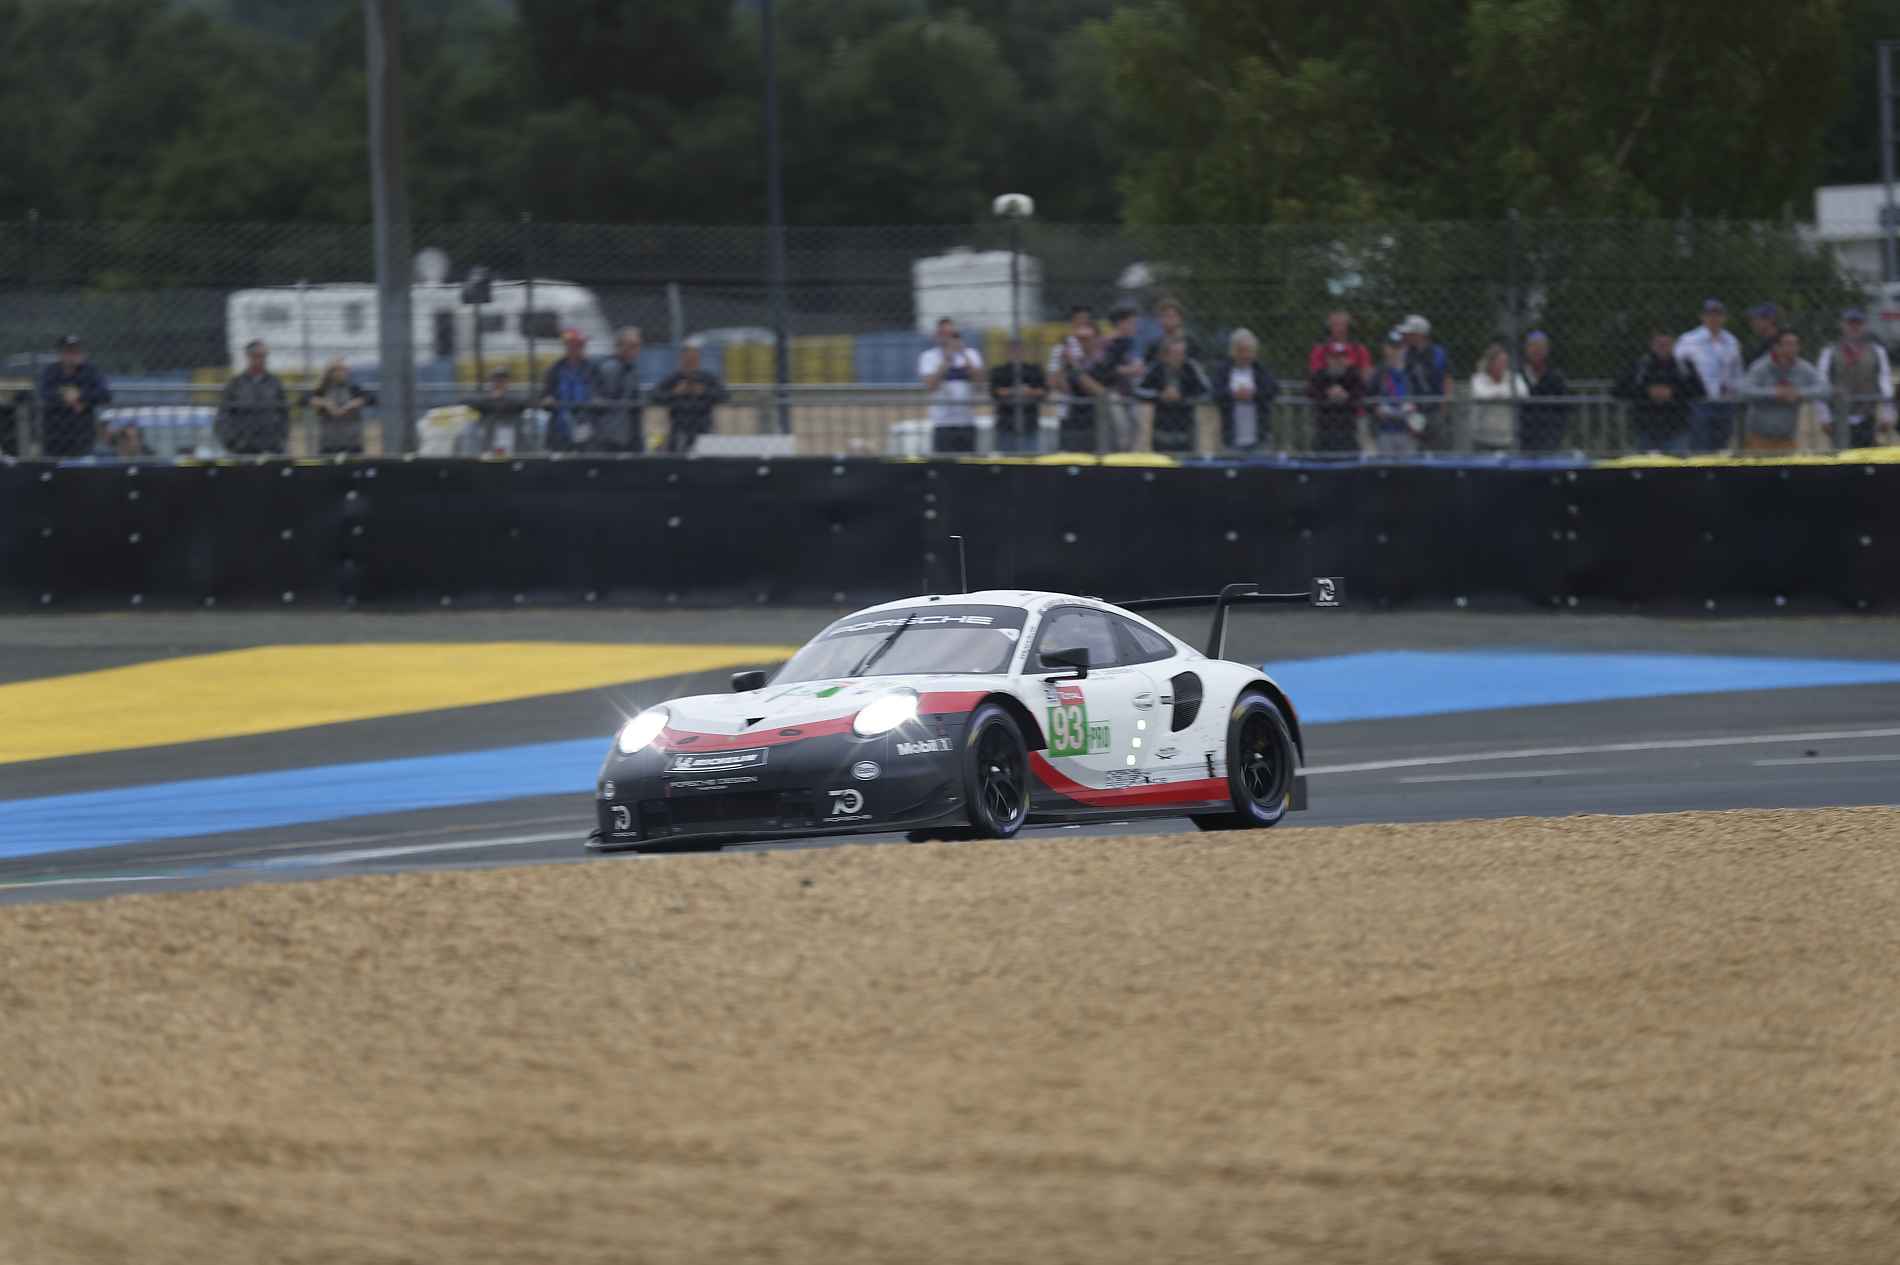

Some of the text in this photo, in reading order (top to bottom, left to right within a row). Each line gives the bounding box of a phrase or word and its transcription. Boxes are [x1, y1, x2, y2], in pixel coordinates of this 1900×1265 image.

[829, 616, 993, 635] PORSCHE
[1054, 705, 1083, 750] 93
[896, 739, 938, 756] Mobil
